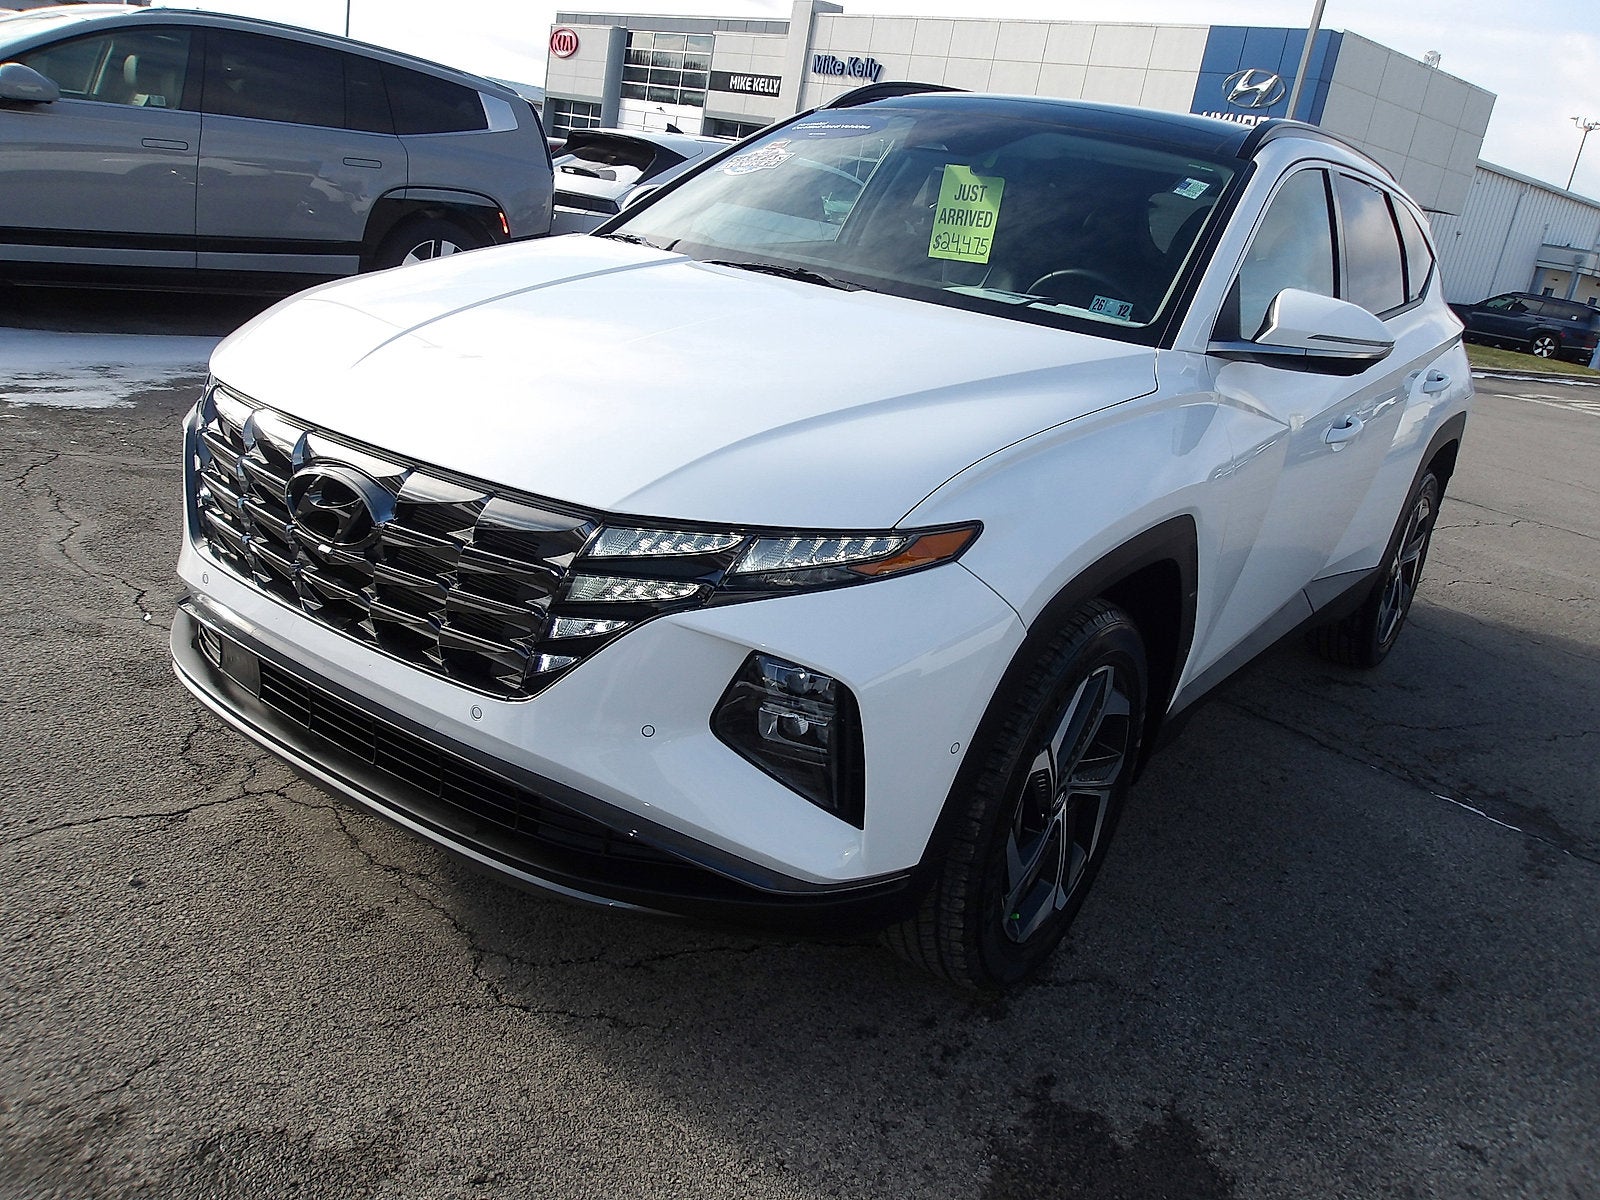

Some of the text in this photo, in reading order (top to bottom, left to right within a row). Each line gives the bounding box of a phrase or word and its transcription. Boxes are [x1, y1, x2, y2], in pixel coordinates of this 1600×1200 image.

[553, 33, 574, 51] KIA
[812, 54, 883, 82] Mike Kelly
[729, 75, 781, 94] MIKE KELLY
[954, 184, 987, 202] JUST
[938, 208, 993, 228] ARRIVED
[933, 231, 989, 255] $24,475
[1092, 298, 1130, 317] 26 12
